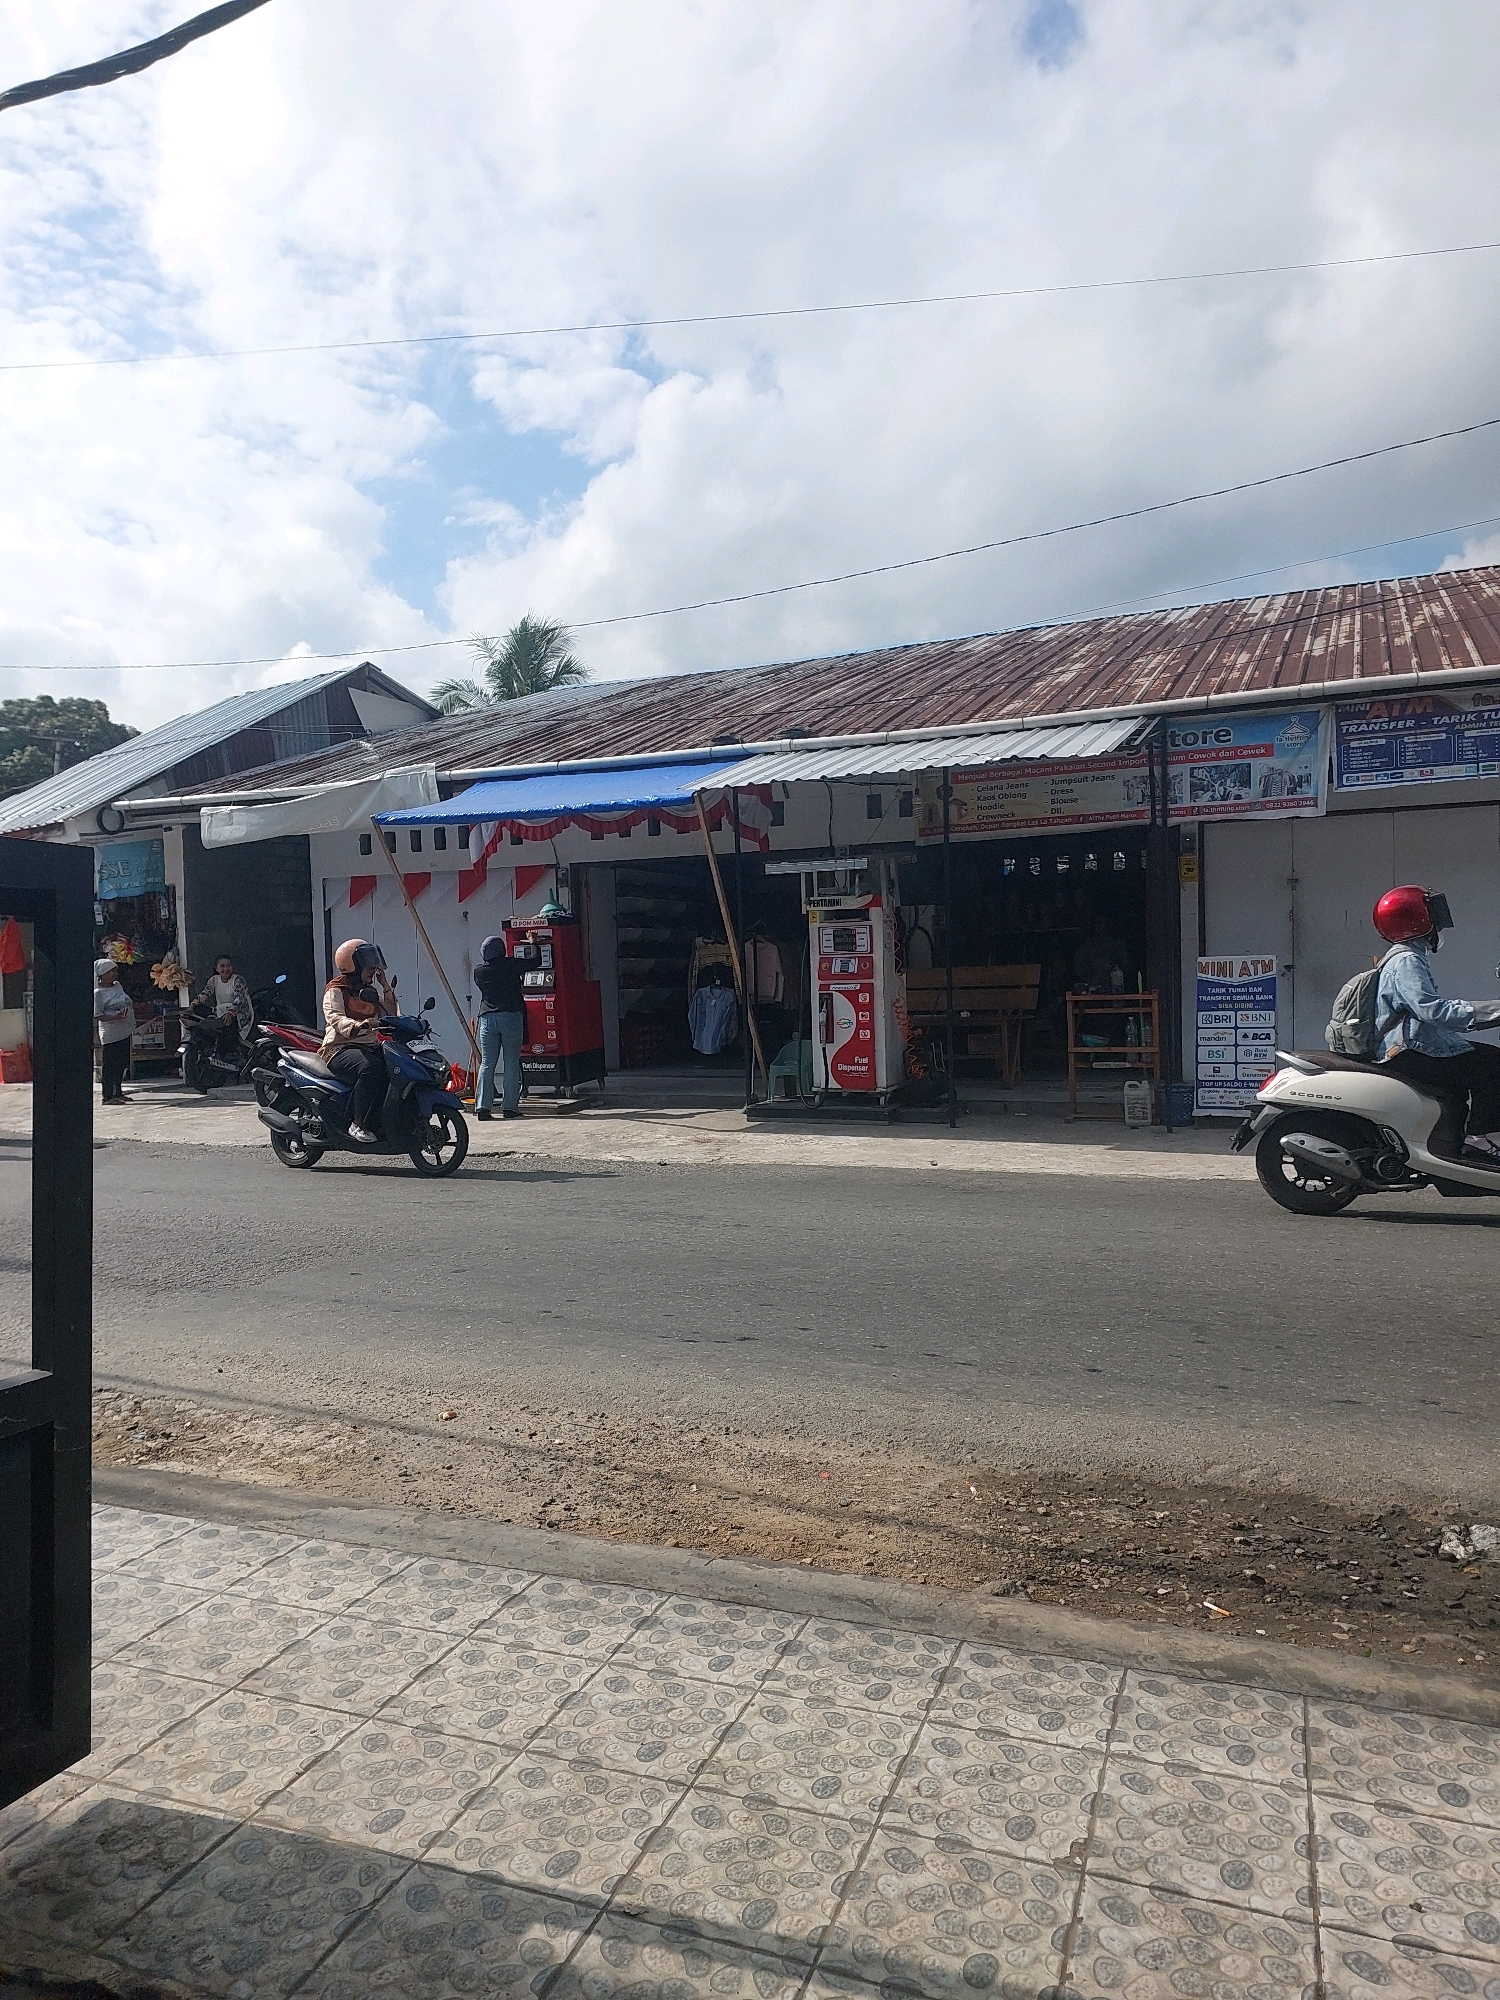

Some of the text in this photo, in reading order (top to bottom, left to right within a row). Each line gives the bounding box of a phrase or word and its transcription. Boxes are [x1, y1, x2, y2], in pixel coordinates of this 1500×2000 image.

[1338, 696, 1434, 720] MINI ATM
[1341, 719, 1415, 733] TRANSFER
[1432, 712, 1478, 725] TARIK
[1454, 721, 1487, 730] ADMIN
[958, 772, 988, 782] Menjual
[989, 768, 1023, 779] Berbagai
[1024, 766, 1053, 775] Macam
[1054, 763, 1086, 773] Pakaian
[1086, 760, 1116, 769] Second
[1118, 757, 1148, 767] Import
[1188, 751, 1217, 760] Cowok
[1218, 749, 1235, 758] dan
[1237, 746, 1267, 756] Cewek
[1049, 773, 1116, 786] Jumpsuit Jeans
[976, 781, 1030, 792] Celana Jeans
[1050, 787, 1075, 796] Dress
[976, 791, 1027, 802] Kaos Oblong
[1050, 796, 1079, 805] Blouse
[976, 802, 1005, 812] Hoodie
[976, 811, 1016, 821] Crewneck
[980, 822, 1000, 832] Depan
[1001, 819, 1027, 829] Bengkel
[1027, 819, 1039, 827] Las
[1049, 816, 1073, 826] Tahzan
[518, 920, 532, 928] POM
[1198, 959, 1274, 978] MINI ATM
[1213, 1014, 1232, 1024] BRI
[1251, 1012, 1271, 1022] BNI
[1251, 1032, 1272, 1041] BCA
[1207, 1049, 1225, 1059] BSI
[854, 1056, 869, 1064] Fuel
[532, 1062, 556, 1070] Dispenser
[837, 1063, 869, 1072] Dispenser
